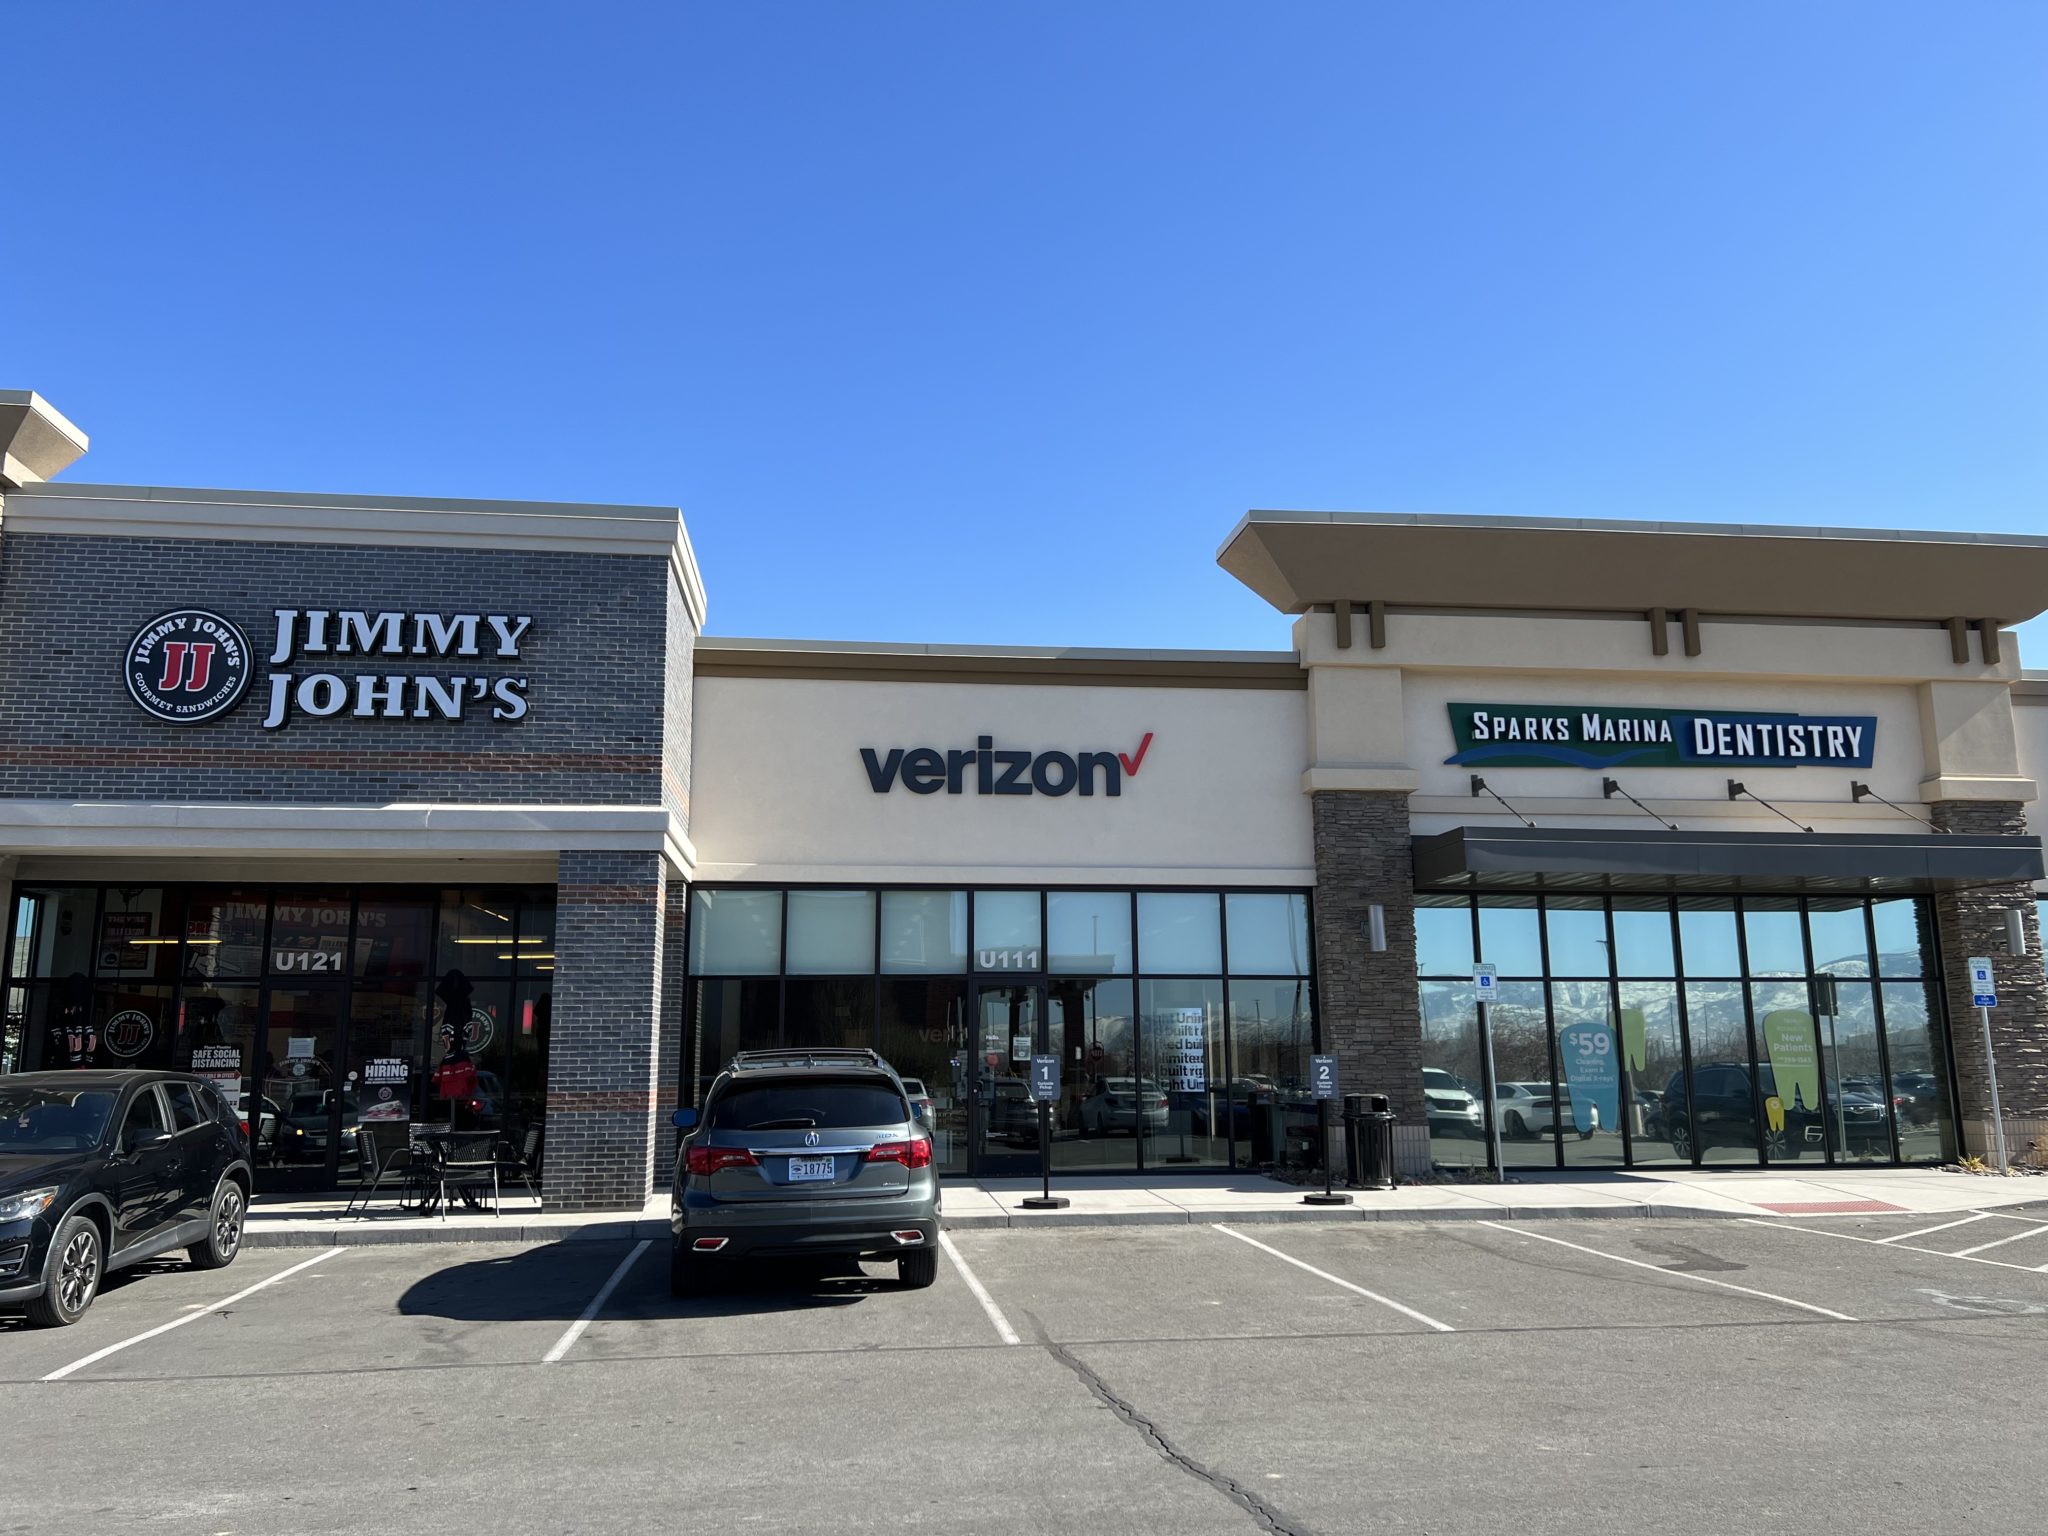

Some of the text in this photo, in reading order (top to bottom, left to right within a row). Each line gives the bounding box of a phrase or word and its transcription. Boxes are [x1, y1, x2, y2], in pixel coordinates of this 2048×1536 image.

[134, 617, 240, 667] JIMMY JOHN'S
[269, 609, 532, 664] JIMMY
[158, 641, 216, 692] JJ
[134, 672, 237, 713] GOURMET SANDWICHES
[262, 673, 529, 728] JOHN'S
[859, 735, 1121, 797] verizon
[276, 951, 343, 971] U121
[980, 950, 1037, 969] U111
[1568, 1032, 1610, 1056] $59
[1781, 1033, 1804, 1042] New
[192, 1049, 241, 1059] SAFE SOCIAL
[1773, 1042, 1814, 1053] Patients
[191, 1058, 240, 1068] DISTANCING
[365, 1064, 409, 1078] HIRING
[1319, 1065, 1330, 1080] 2
[1041, 1066, 1049, 1080] 1
[803, 1162, 833, 1175] 18775
